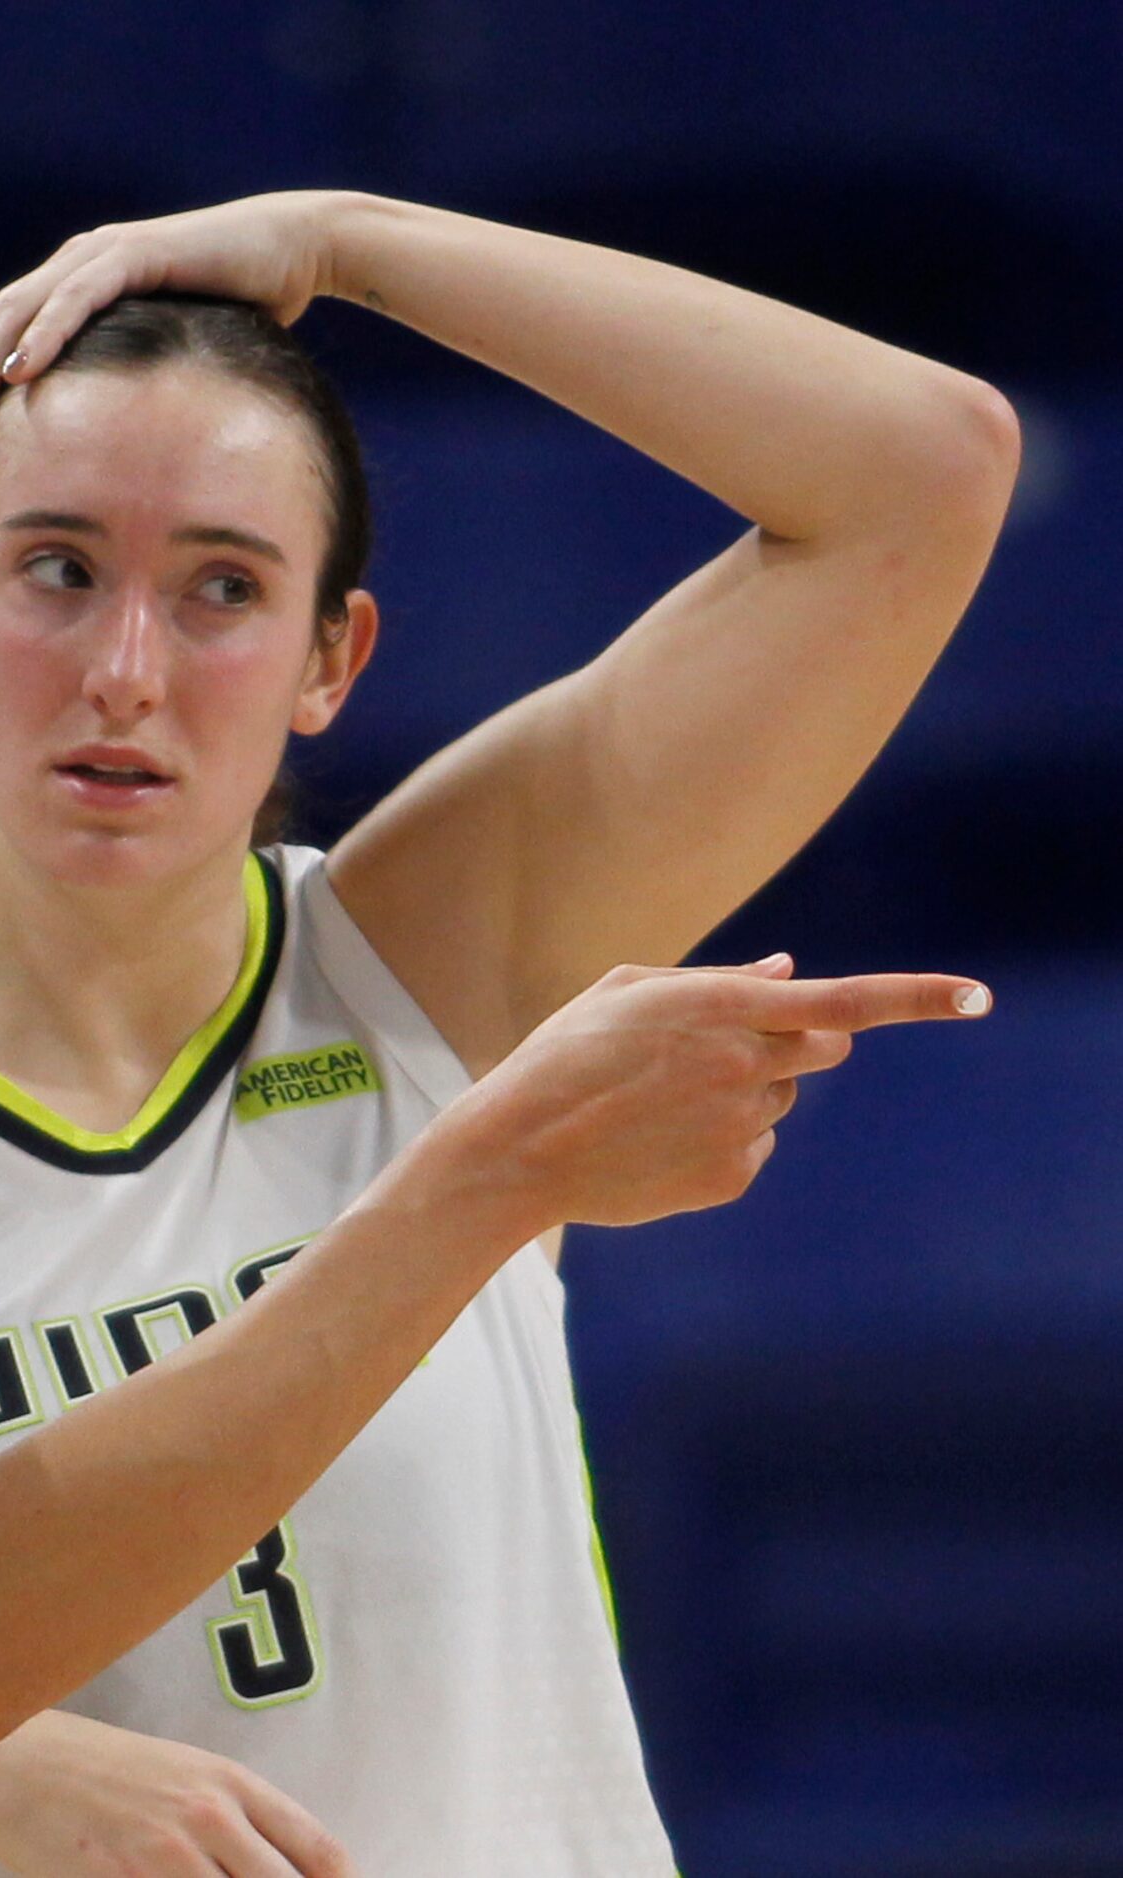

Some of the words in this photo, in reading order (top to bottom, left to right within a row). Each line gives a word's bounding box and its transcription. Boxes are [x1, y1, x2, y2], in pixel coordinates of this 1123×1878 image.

[235, 1049, 364, 1102] AMERICAN
[260, 1068, 368, 1107] FIDELITY
[206, 1515, 325, 1711] 3
